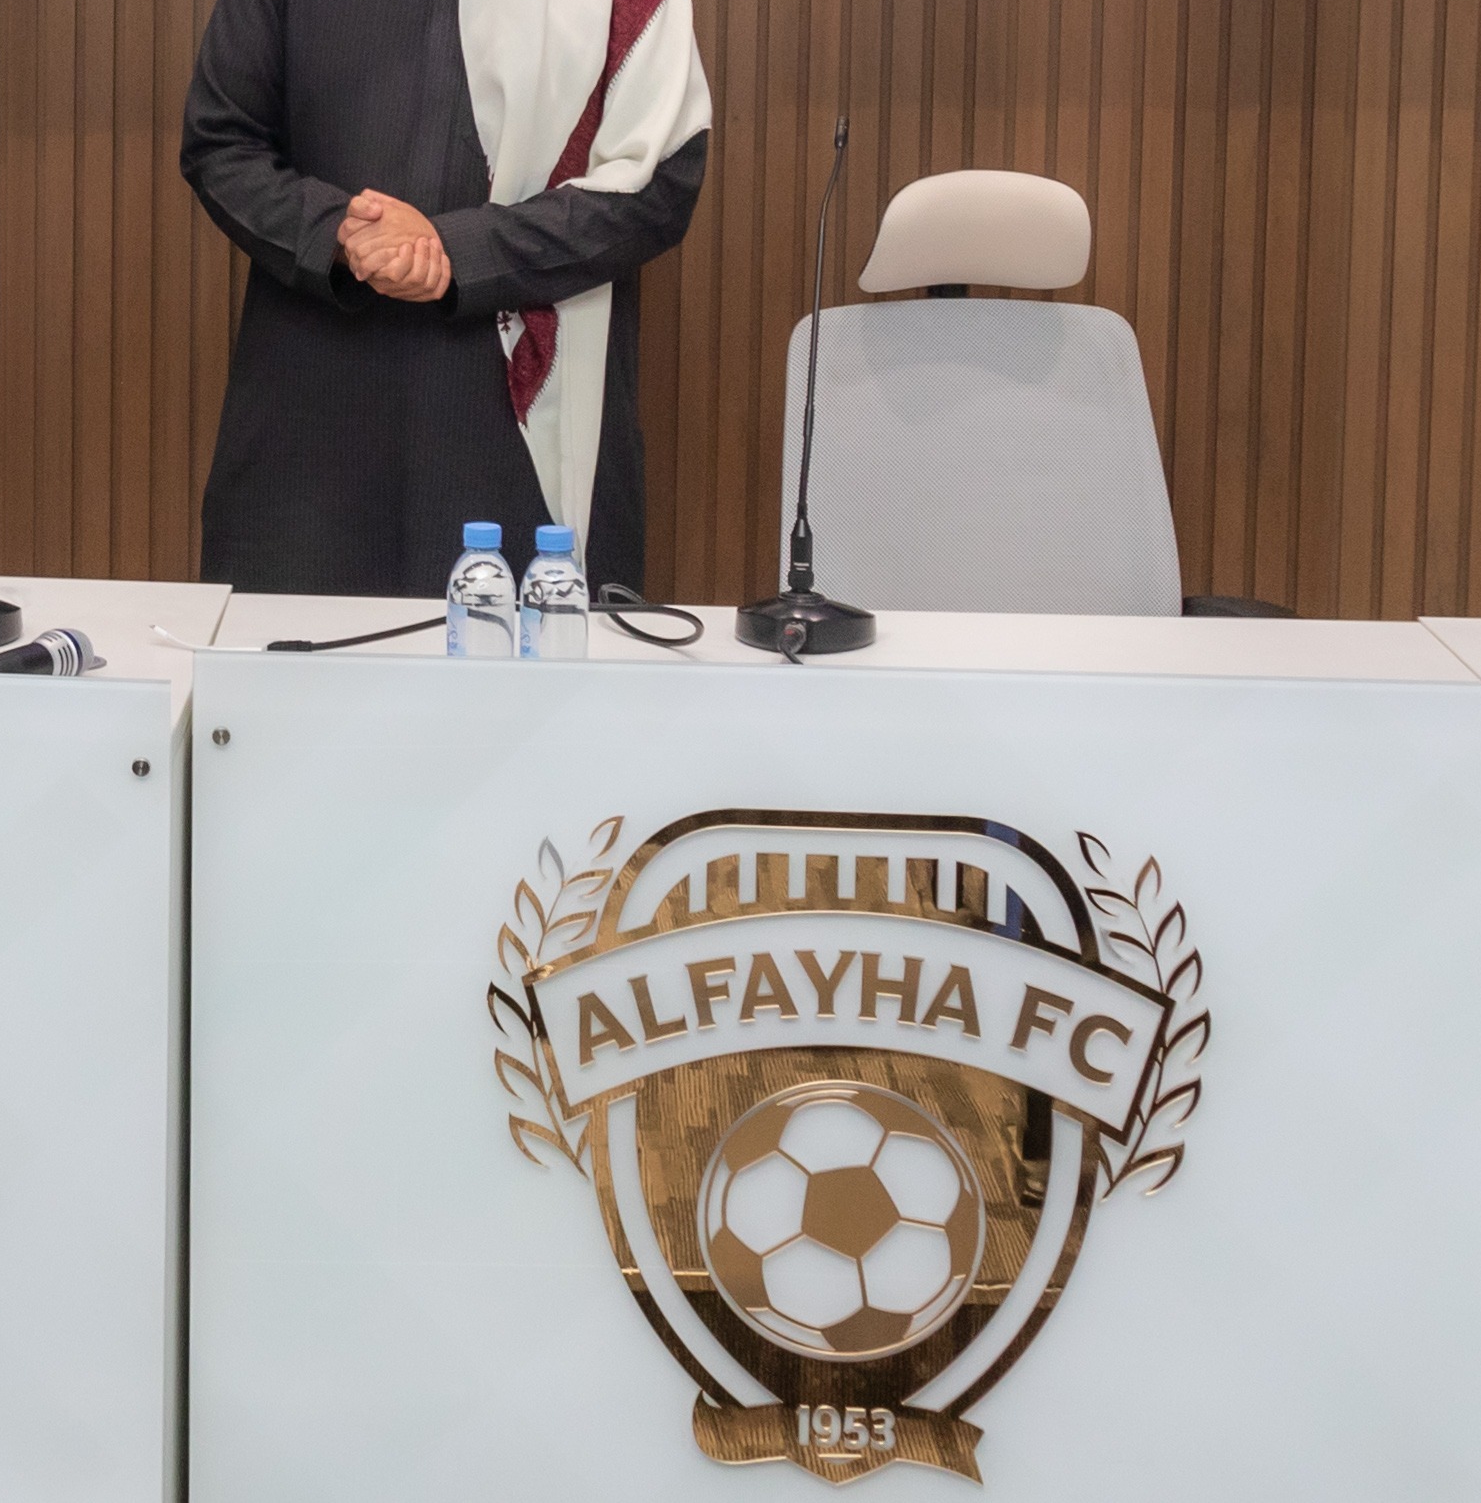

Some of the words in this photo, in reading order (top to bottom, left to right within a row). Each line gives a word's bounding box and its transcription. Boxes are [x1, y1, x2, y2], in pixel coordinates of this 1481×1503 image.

[576, 948, 982, 1068] ALFAYHA
[1008, 982, 1134, 1086] FC
[794, 1403, 898, 1452] 1953
